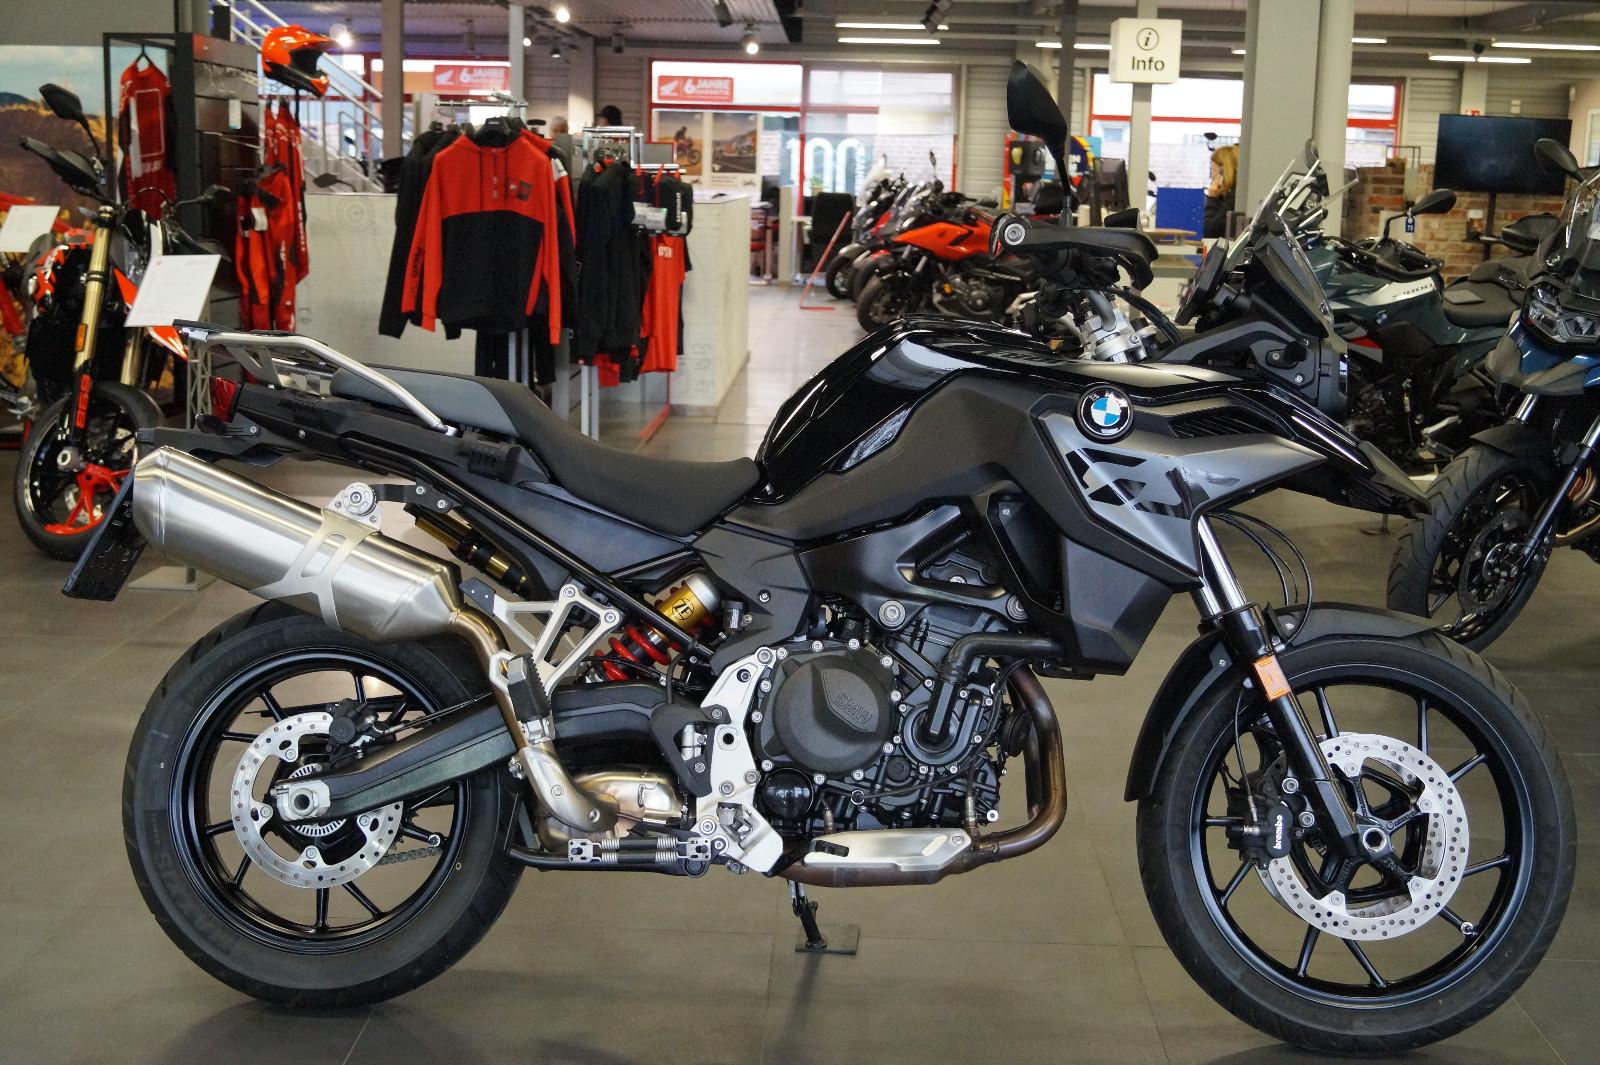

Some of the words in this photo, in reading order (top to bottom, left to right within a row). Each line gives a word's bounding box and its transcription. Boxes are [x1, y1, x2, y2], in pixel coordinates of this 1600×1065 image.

[1131, 55, 1165, 71] Info
[683, 78, 695, 94] 6
[833, 691, 873, 724] BMW
[1273, 814, 1283, 850] brembo
